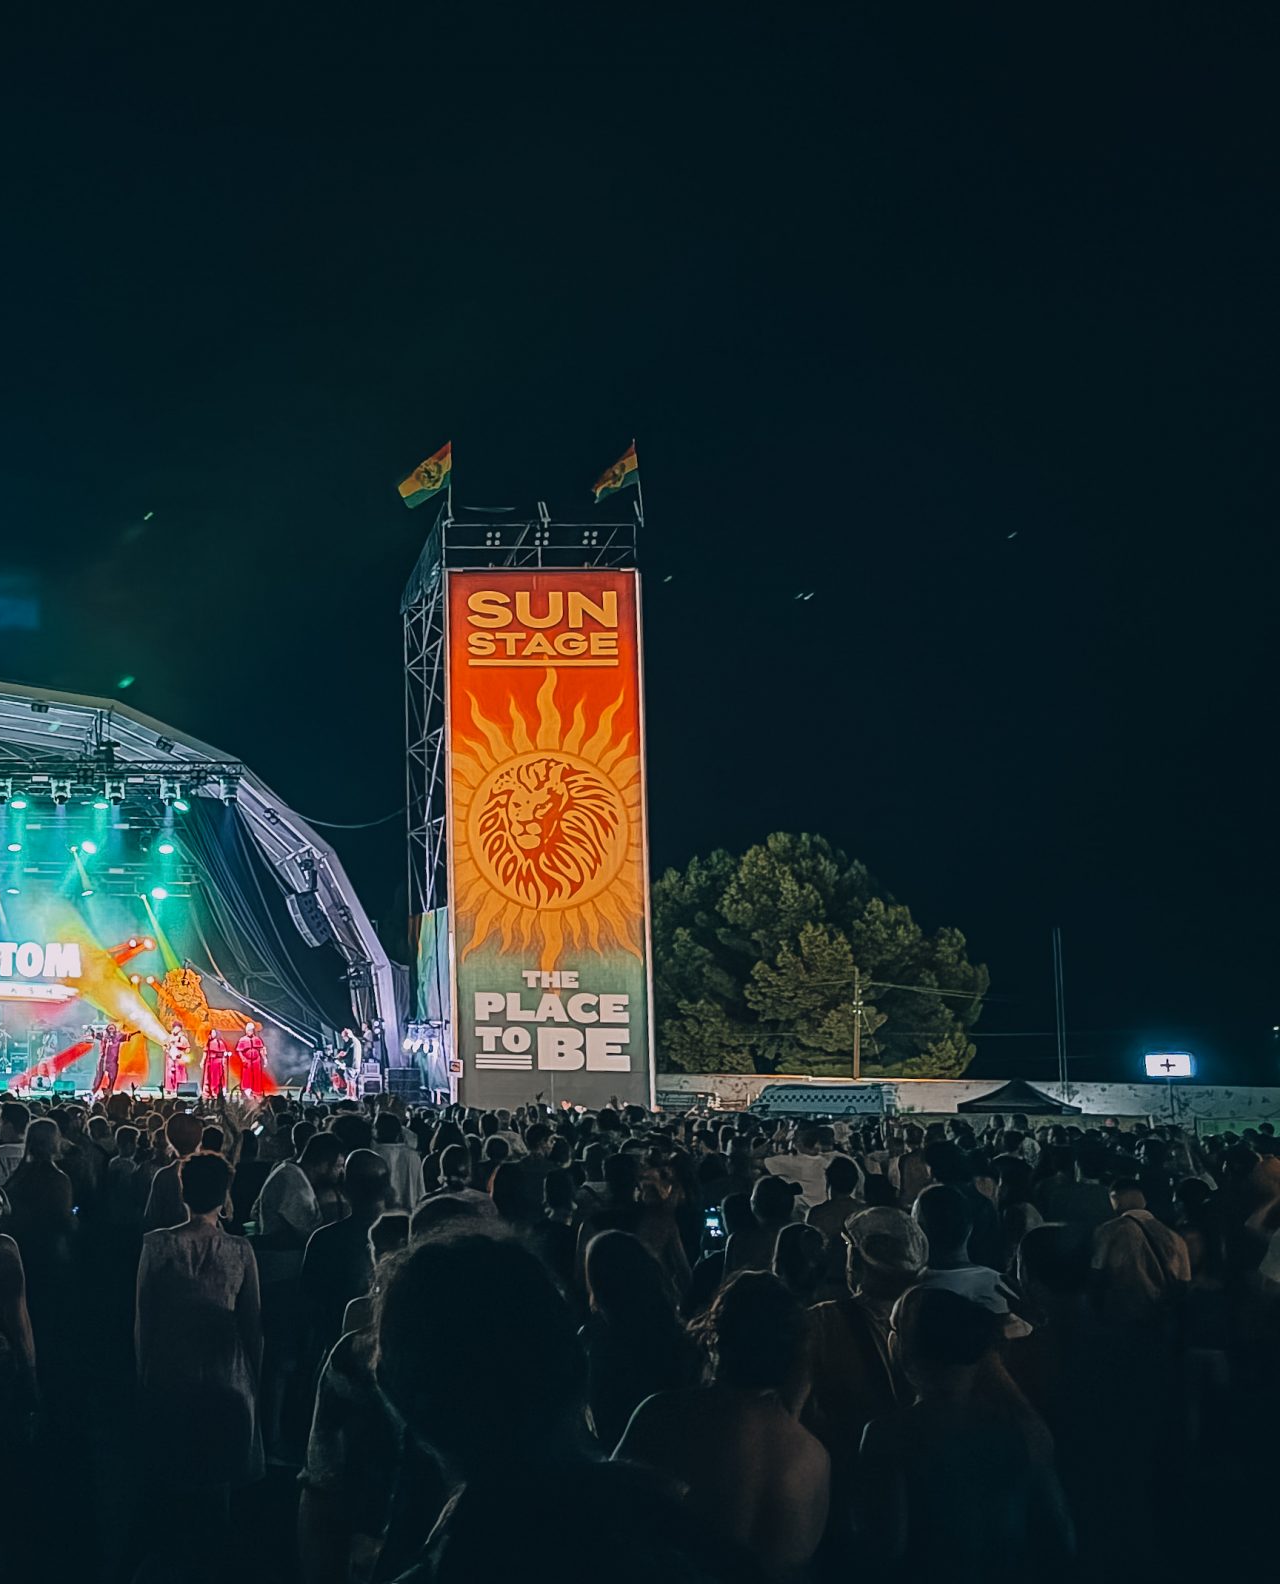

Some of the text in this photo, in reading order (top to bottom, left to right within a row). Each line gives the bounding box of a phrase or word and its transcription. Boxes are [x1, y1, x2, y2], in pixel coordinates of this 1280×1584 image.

[466, 590, 618, 629] SUN
[467, 631, 619, 656] STAGE
[522, 970, 580, 989] THE
[474, 991, 630, 1024] PLACE
[475, 1026, 631, 1072] TO BE
